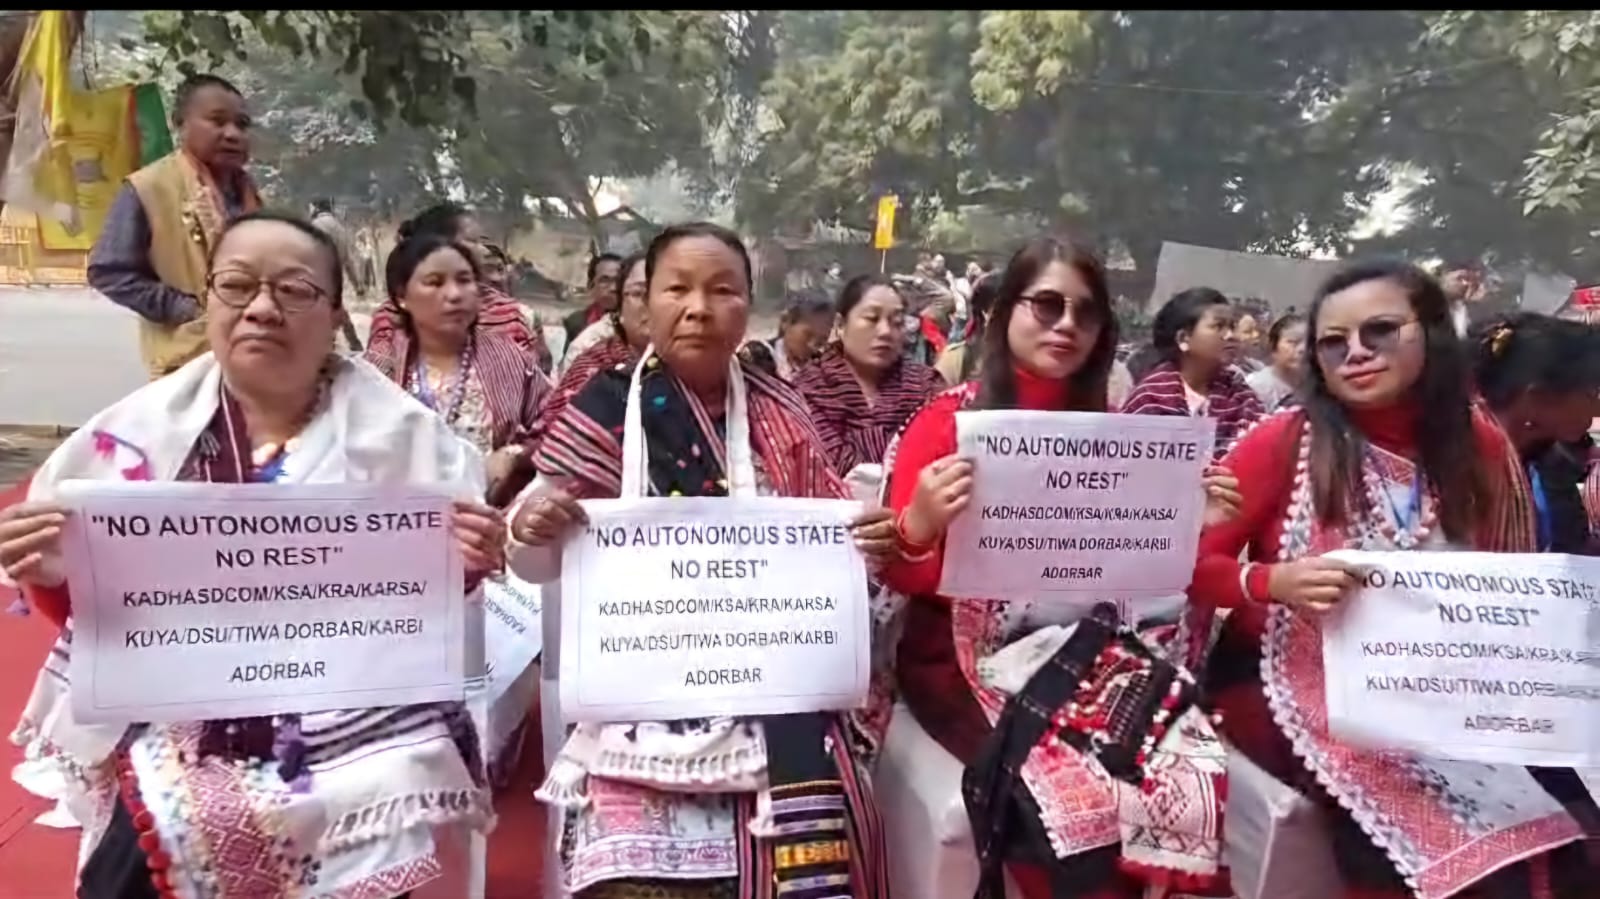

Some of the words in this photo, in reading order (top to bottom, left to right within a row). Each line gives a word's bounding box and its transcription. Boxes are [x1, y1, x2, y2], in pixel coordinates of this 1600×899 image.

[977, 436, 1012, 457] "NO
[1015, 437, 1142, 459] AUTONOMOUS
[1146, 441, 1198, 461] STATE
[1046, 471, 1072, 490] NO
[1076, 471, 1129, 490] REST"
[91, 514, 150, 539] "NO
[158, 512, 359, 536] AUTONOMOUS
[366, 510, 442, 532] STATE
[586, 527, 626, 548] "NO
[632, 525, 780, 547] AUTONOMOUS
[785, 524, 845, 546] STATE
[216, 547, 255, 569] NO
[263, 545, 344, 567] REST"
[671, 559, 700, 580] NO
[706, 559, 769, 579] REST"
[123, 579, 428, 608] KADHASDCOM/KSA/KRA/KARSA/
[1392, 570, 1545, 596] AUTONOMOUS
[1438, 602, 1473, 624] NO
[125, 626, 280, 649] KUYA/DSU/TIWA
[284, 618, 424, 641] DORBAR/KARBI
[600, 632, 723, 655] KUYA/DSU/TIWA
[725, 629, 839, 648] DORBAR/KARBI
[229, 660, 327, 684] ADORBAR
[684, 667, 763, 687] ADORBAR
